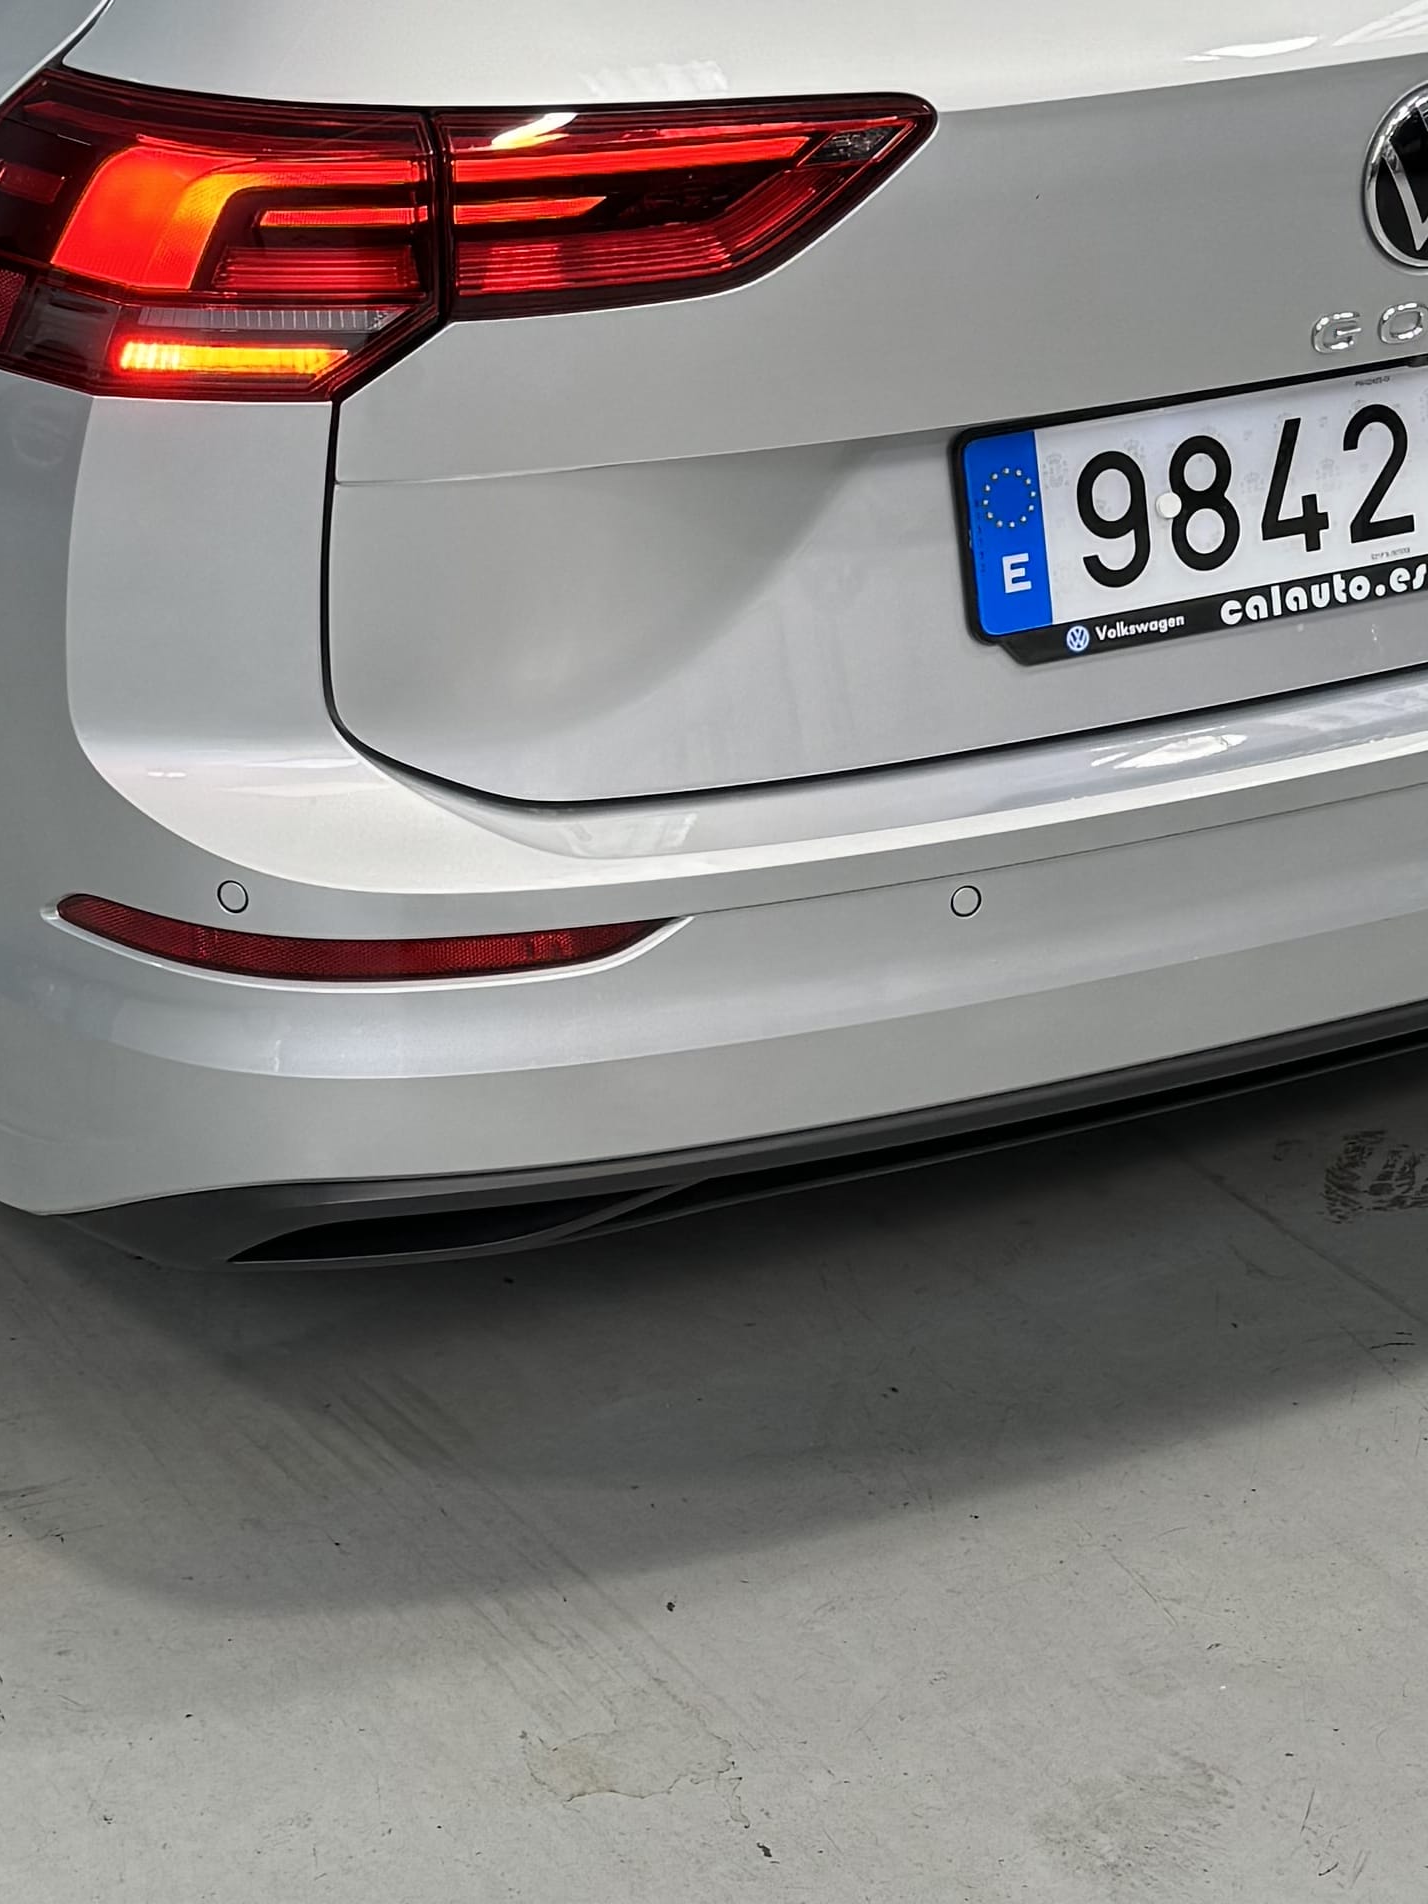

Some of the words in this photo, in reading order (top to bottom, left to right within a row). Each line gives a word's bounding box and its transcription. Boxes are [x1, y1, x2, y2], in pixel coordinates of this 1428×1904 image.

[1077, 404, 1415, 588] 9842
[1002, 552, 1032, 594] E
[1220, 563, 1428, 625] calauto.es
[1095, 614, 1185, 641] Volkswagen
